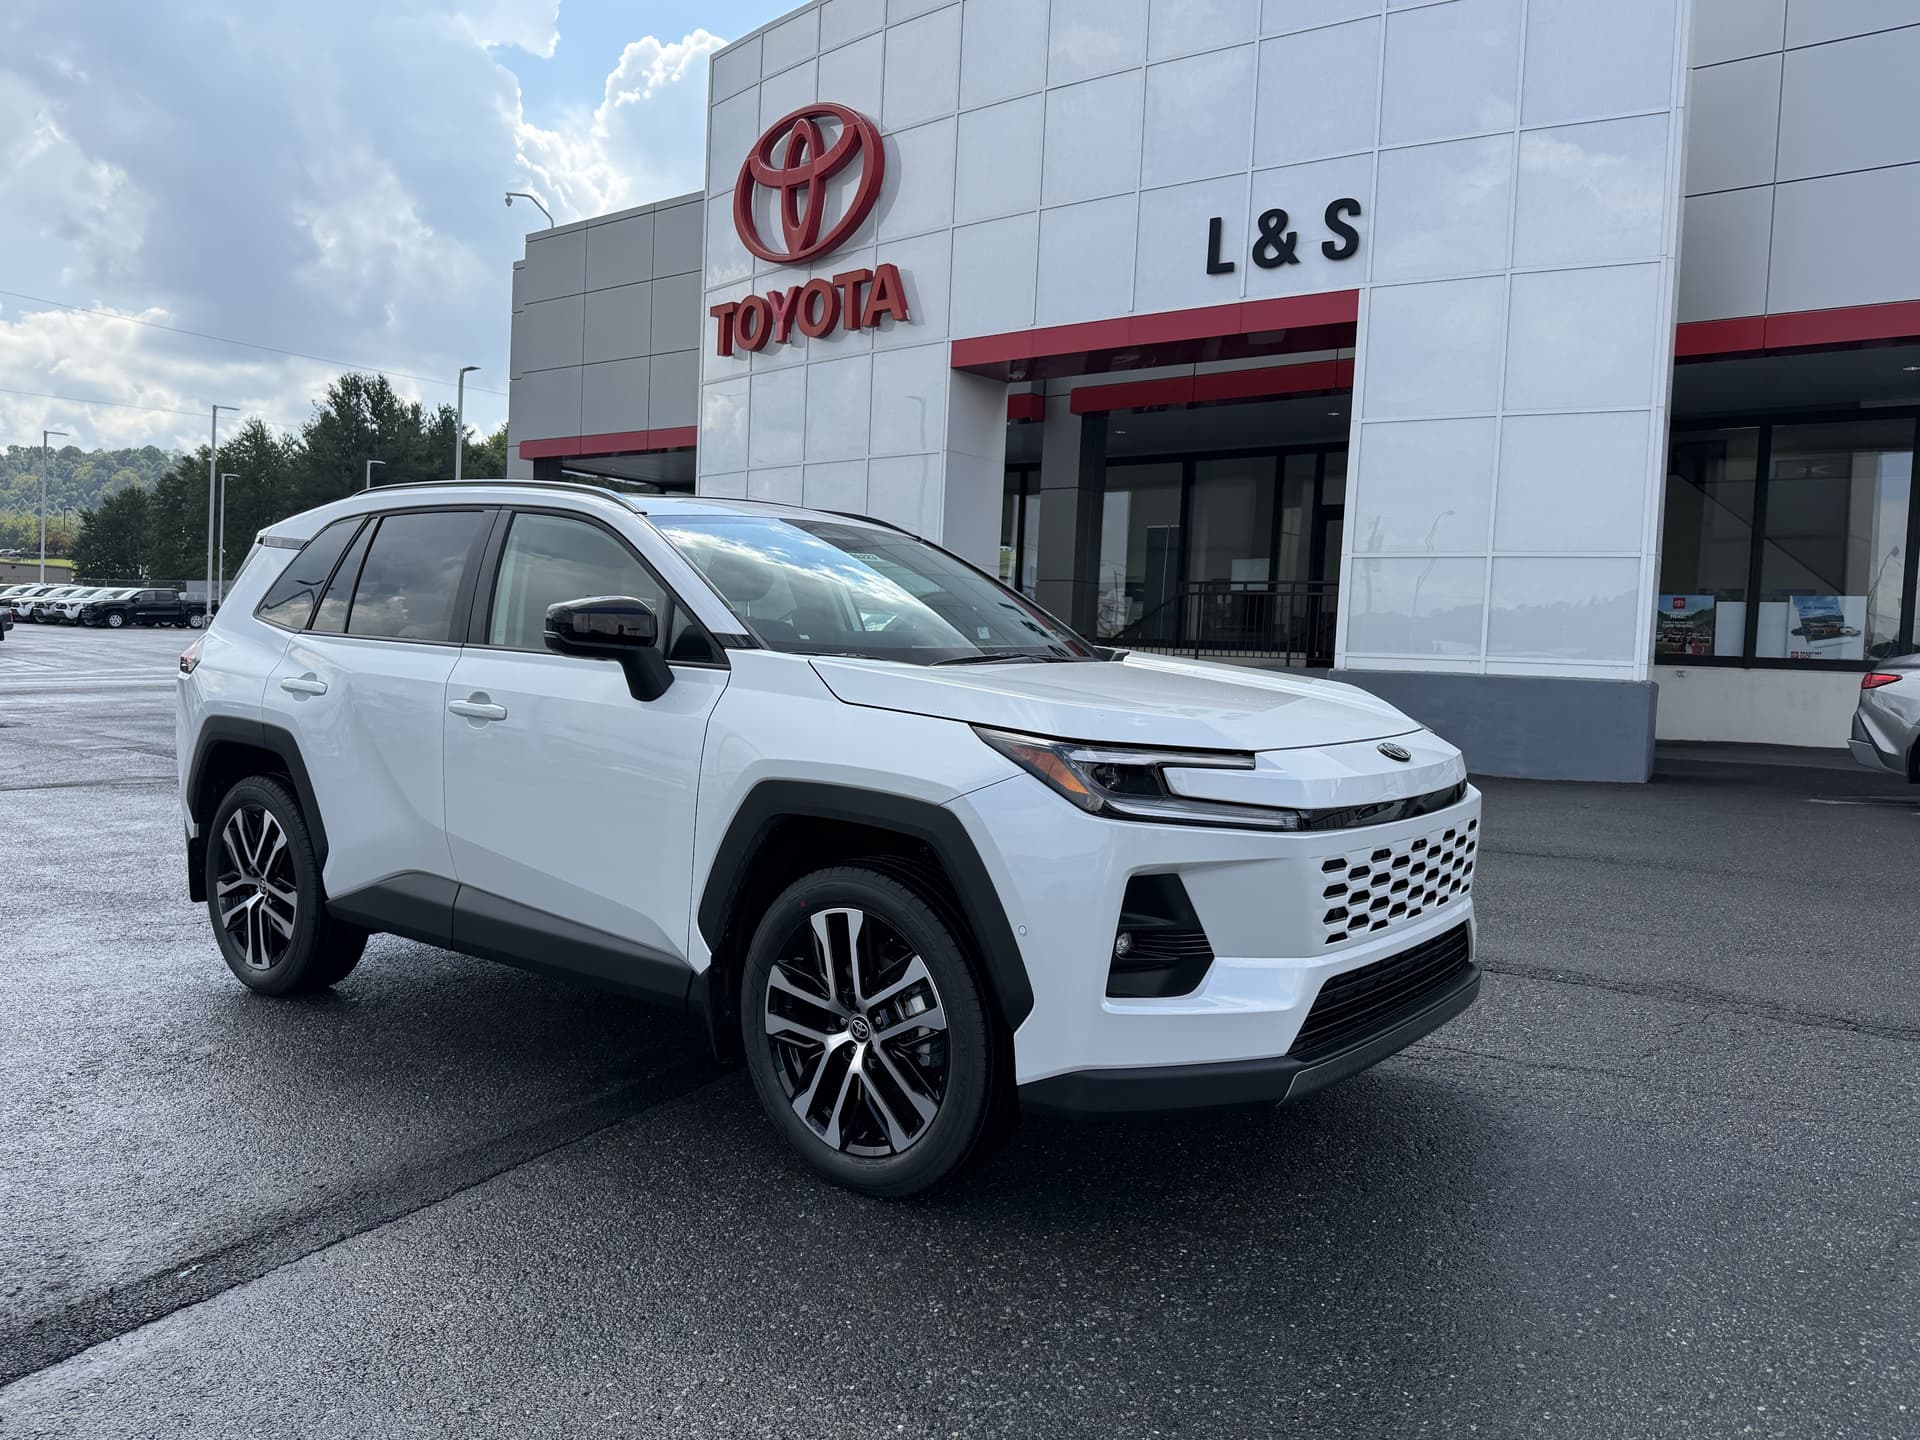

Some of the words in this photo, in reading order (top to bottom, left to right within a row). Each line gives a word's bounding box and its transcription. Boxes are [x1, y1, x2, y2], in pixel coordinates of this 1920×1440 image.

[1207, 216, 1235, 274] L
[1252, 208, 1300, 269] &
[1321, 197, 1361, 260] S
[710, 263, 911, 356] TOYOTA
